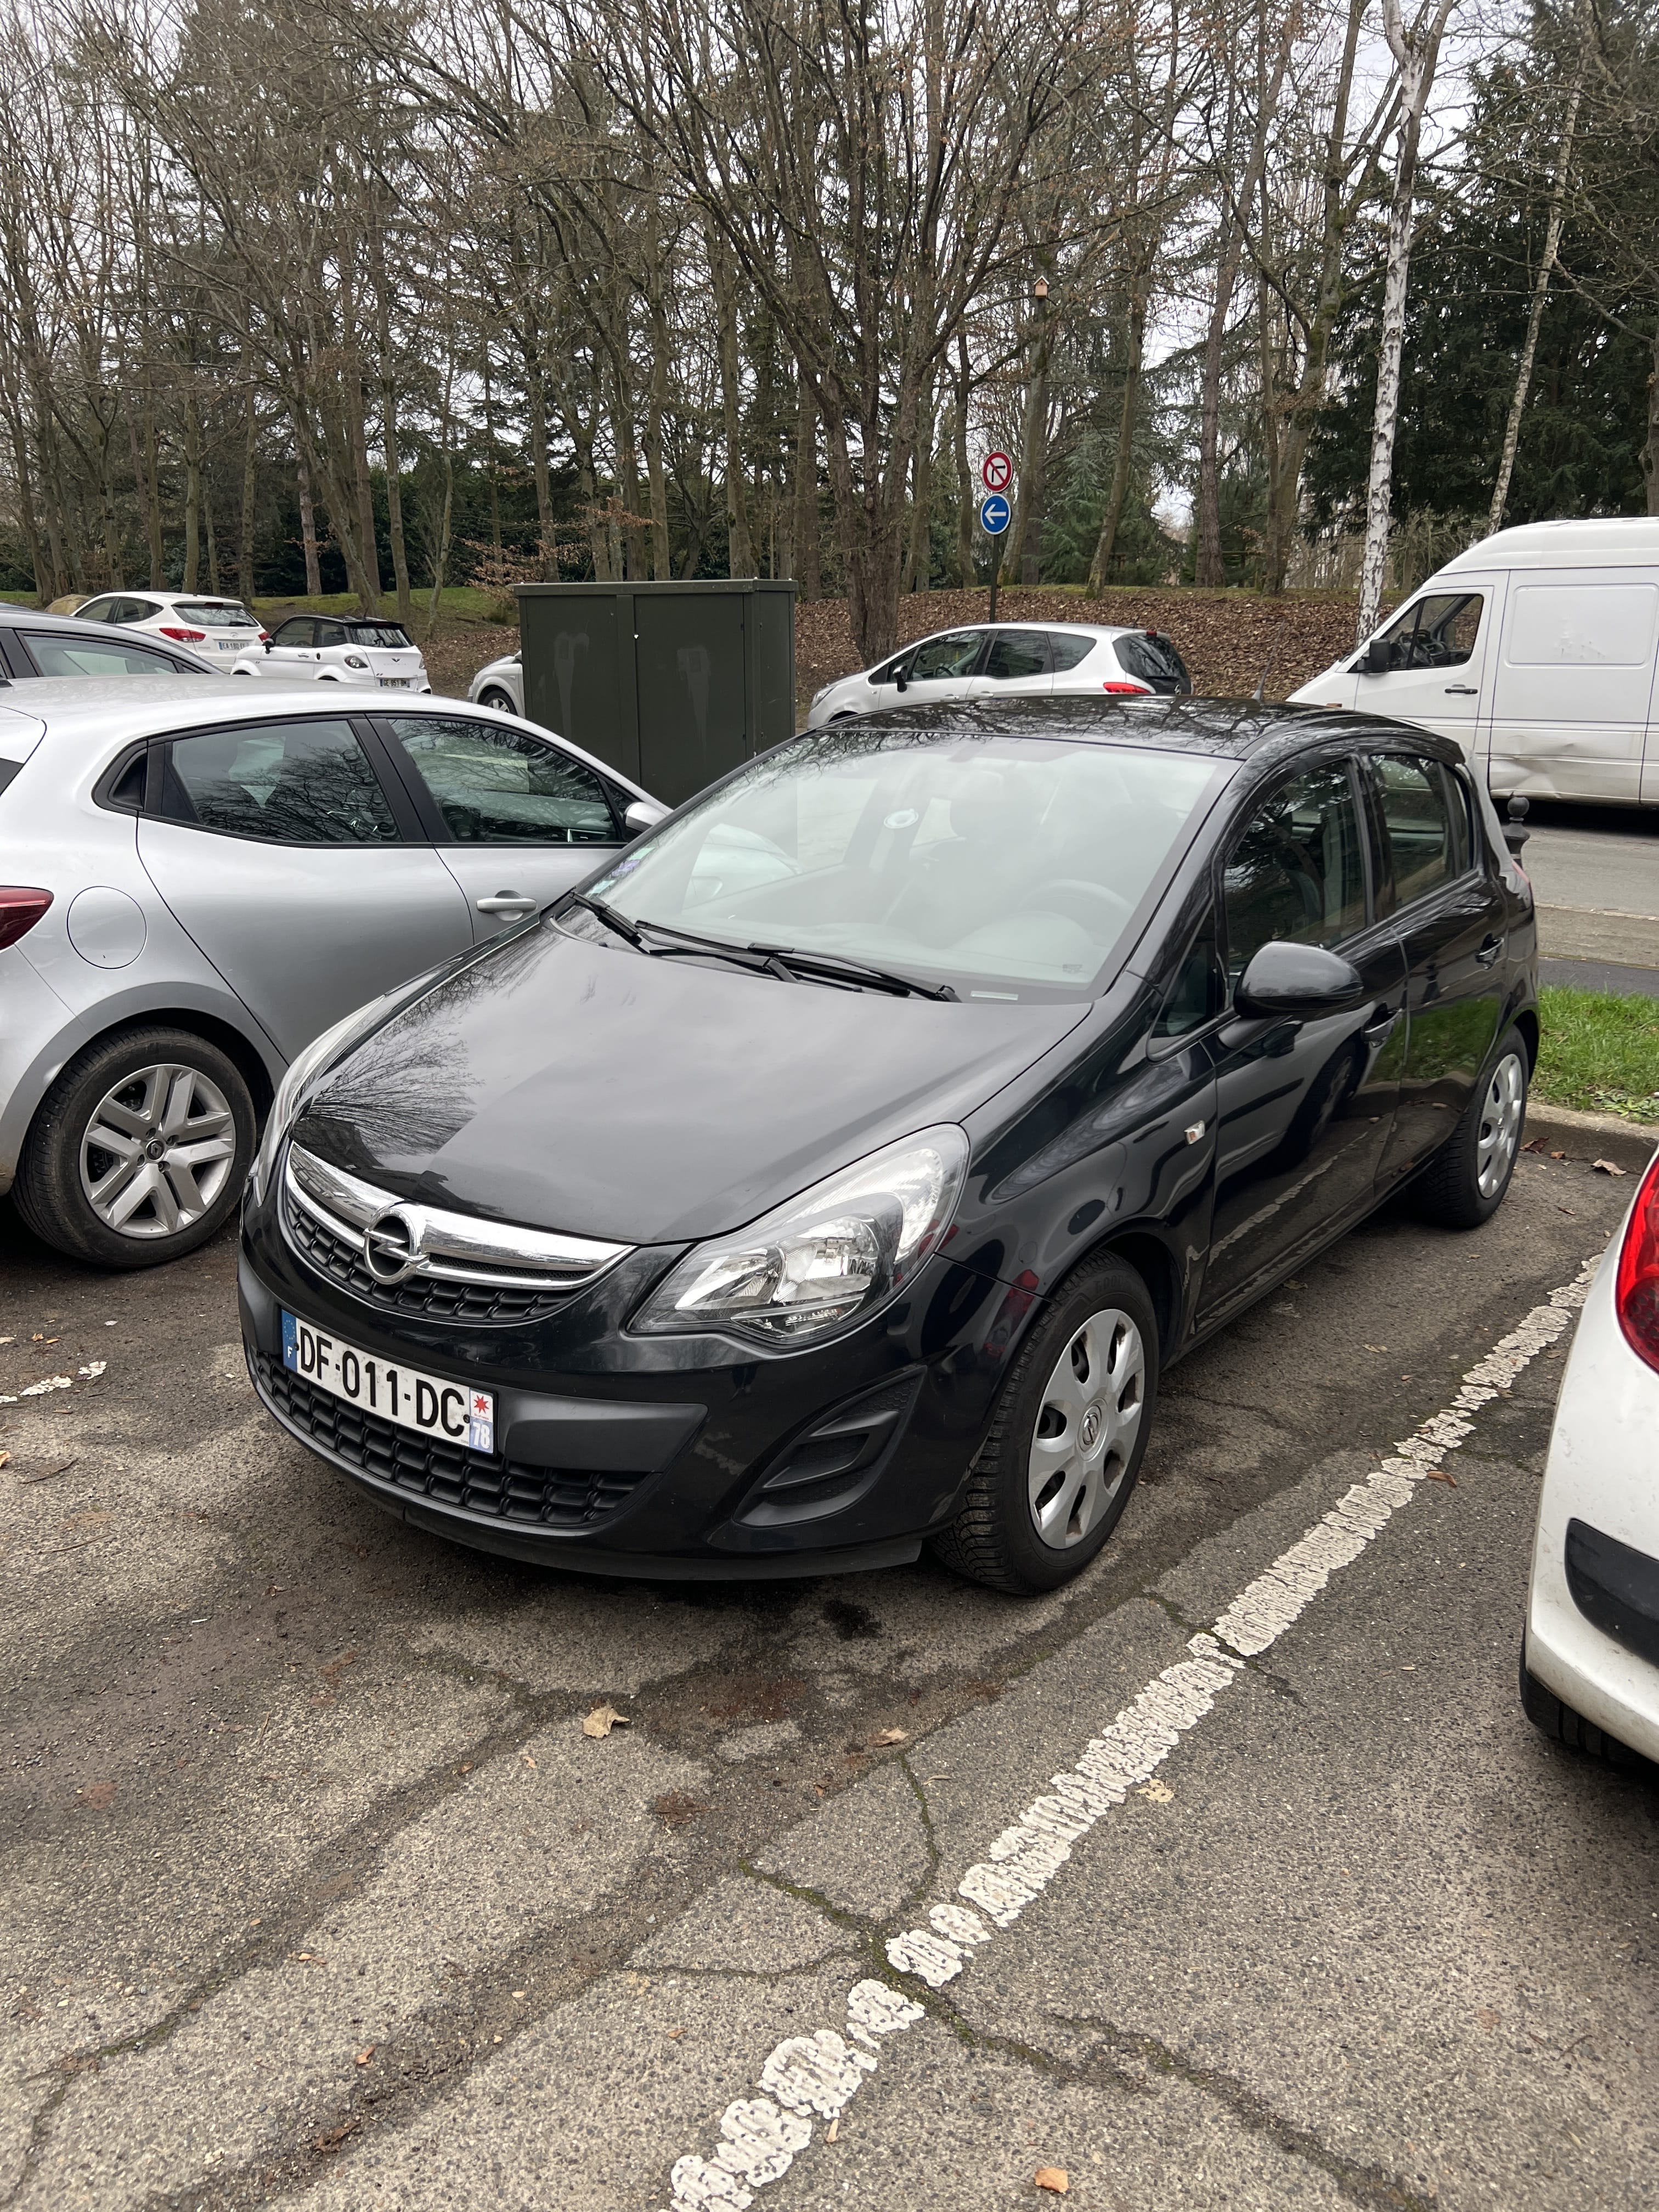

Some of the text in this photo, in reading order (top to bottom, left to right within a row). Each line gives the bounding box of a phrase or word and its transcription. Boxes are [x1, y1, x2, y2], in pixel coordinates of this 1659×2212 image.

[287, 1346, 293, 1358] F
[300, 1326, 465, 1437] DF-011-DC
[473, 1421, 490, 1449] 78
